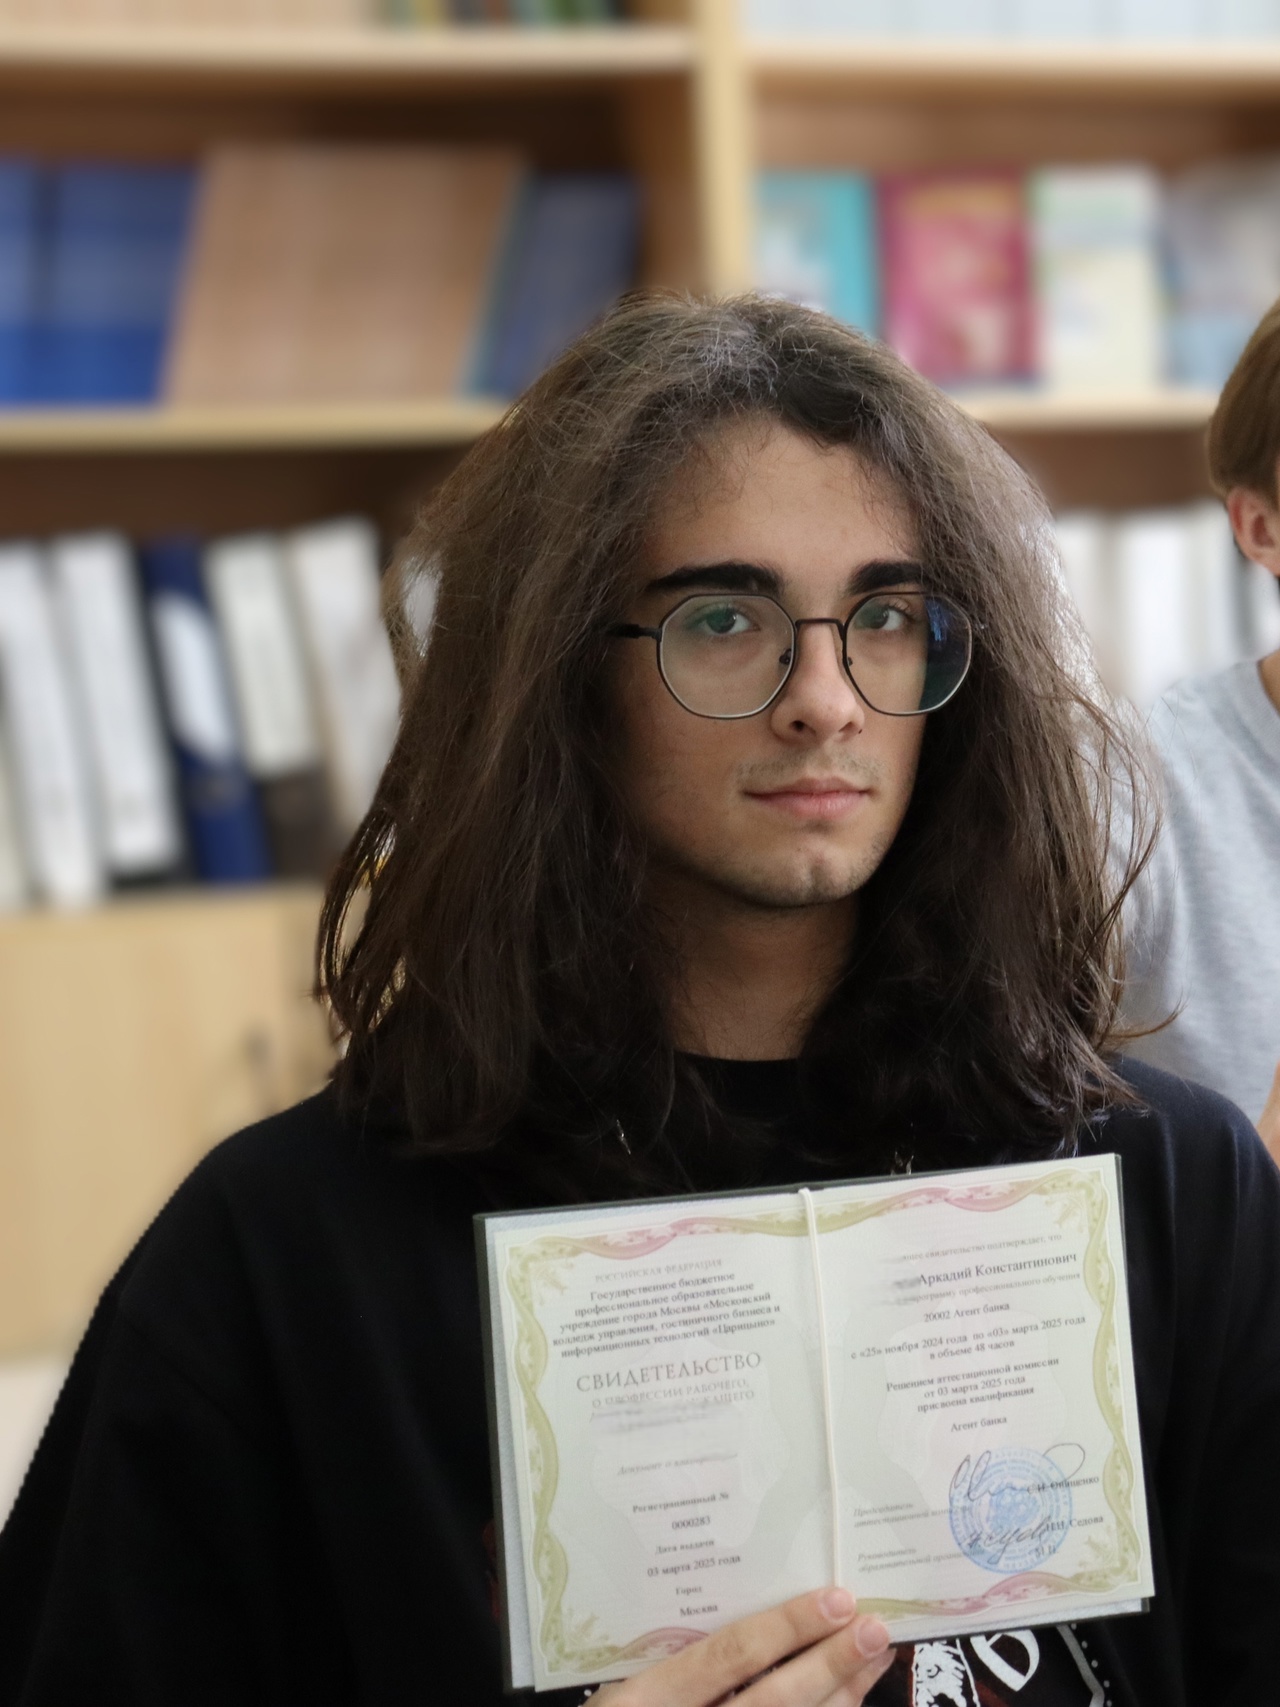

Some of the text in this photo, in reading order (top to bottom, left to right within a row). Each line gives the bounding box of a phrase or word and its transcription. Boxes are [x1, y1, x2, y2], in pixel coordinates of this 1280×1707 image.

[918, 1267, 972, 1287] Аркадий
[974, 1254, 1077, 1277] Константинович
[574, 1284, 754, 1317] профессиональное образовательное
[590, 1274, 735, 1301] Государственное бюджетное
[559, 1291, 771, 1333] учреждение города Москвы «Московский
[923, 1304, 1010, 1323] 20002 Агент банка
[552, 1333, 594, 1346] колледж
[597, 1324, 658, 1341] управления,
[660, 1313, 729, 1330] гостиничного
[731, 1307, 771, 1319] бизнеса
[561, 1319, 775, 1358] информационных технологий «Царицыно»
[859, 1347, 882, 1358] «25»
[884, 1342, 918, 1354] ноября
[920, 1337, 943, 1349] 2024
[945, 1335, 967, 1345] года
[972, 1332, 984, 1341] по
[987, 1327, 1009, 1338] «03»
[1011, 1324, 1038, 1335] марта
[1040, 1318, 1062, 1330] 2025
[1064, 1316, 1086, 1326] года
[937, 1347, 972, 1358] объеме
[974, 1343, 986, 1353] 48
[988, 1340, 1015, 1351] часов
[576, 1351, 762, 1392] СВИДЕТЕЛЬСТВО
[886, 1358, 1059, 1391] Решением аттестационной комиссии
[917, 1387, 1034, 1413] присвоена квалификация
[923, 1376, 1025, 1398] от 03 марта 2025 года
[949, 1417, 1007, 1432] Агент банка
[671, 1515, 711, 1530] 0000283
[1069, 1516, 1104, 1528] Седова
[647, 1555, 741, 1577] 03 марта 2025 года
[675, 1585, 702, 1596] Город
[679, 1603, 718, 1615] Москва
